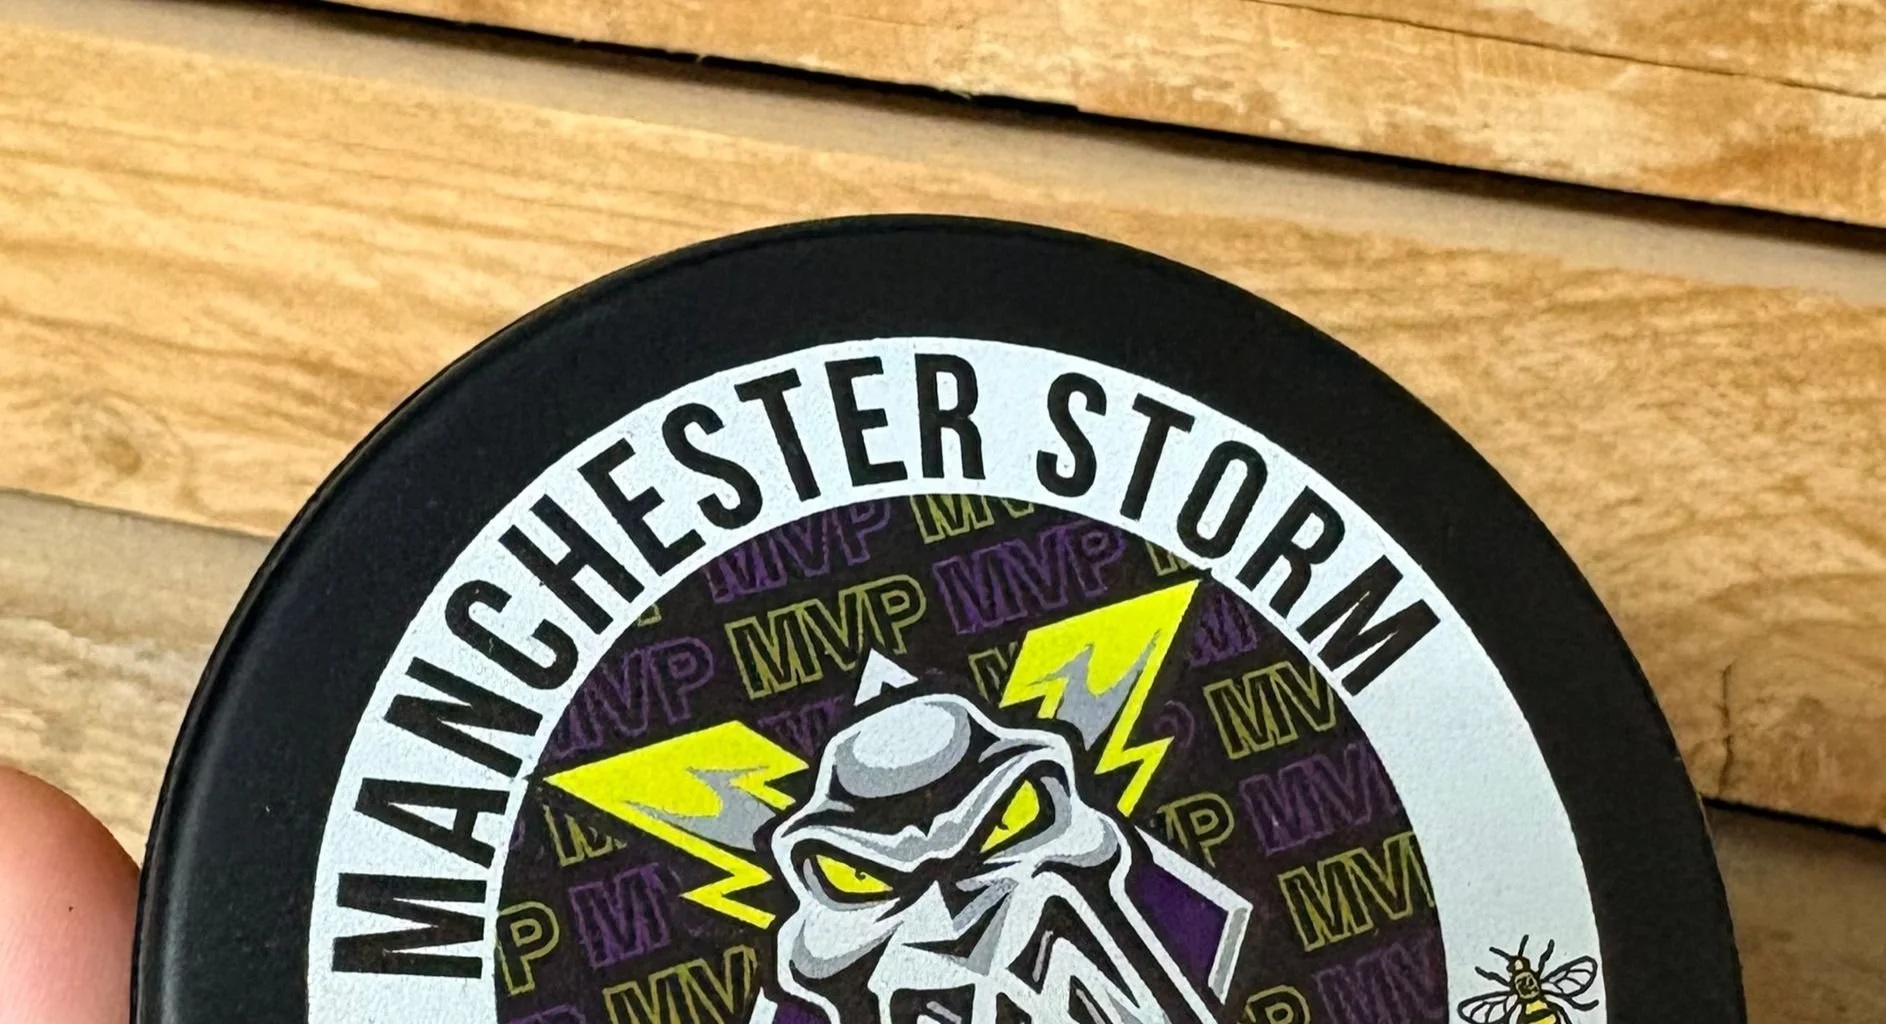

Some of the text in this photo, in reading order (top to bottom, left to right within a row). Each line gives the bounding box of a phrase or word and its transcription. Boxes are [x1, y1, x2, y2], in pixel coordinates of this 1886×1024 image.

[725, 574, 927, 700] MVP
[932, 519, 1128, 636] MVP
[332, 353, 1441, 979] MANCHESTER STORM
[1239, 739, 1400, 856] MV
[1277, 831, 1435, 951] MV
